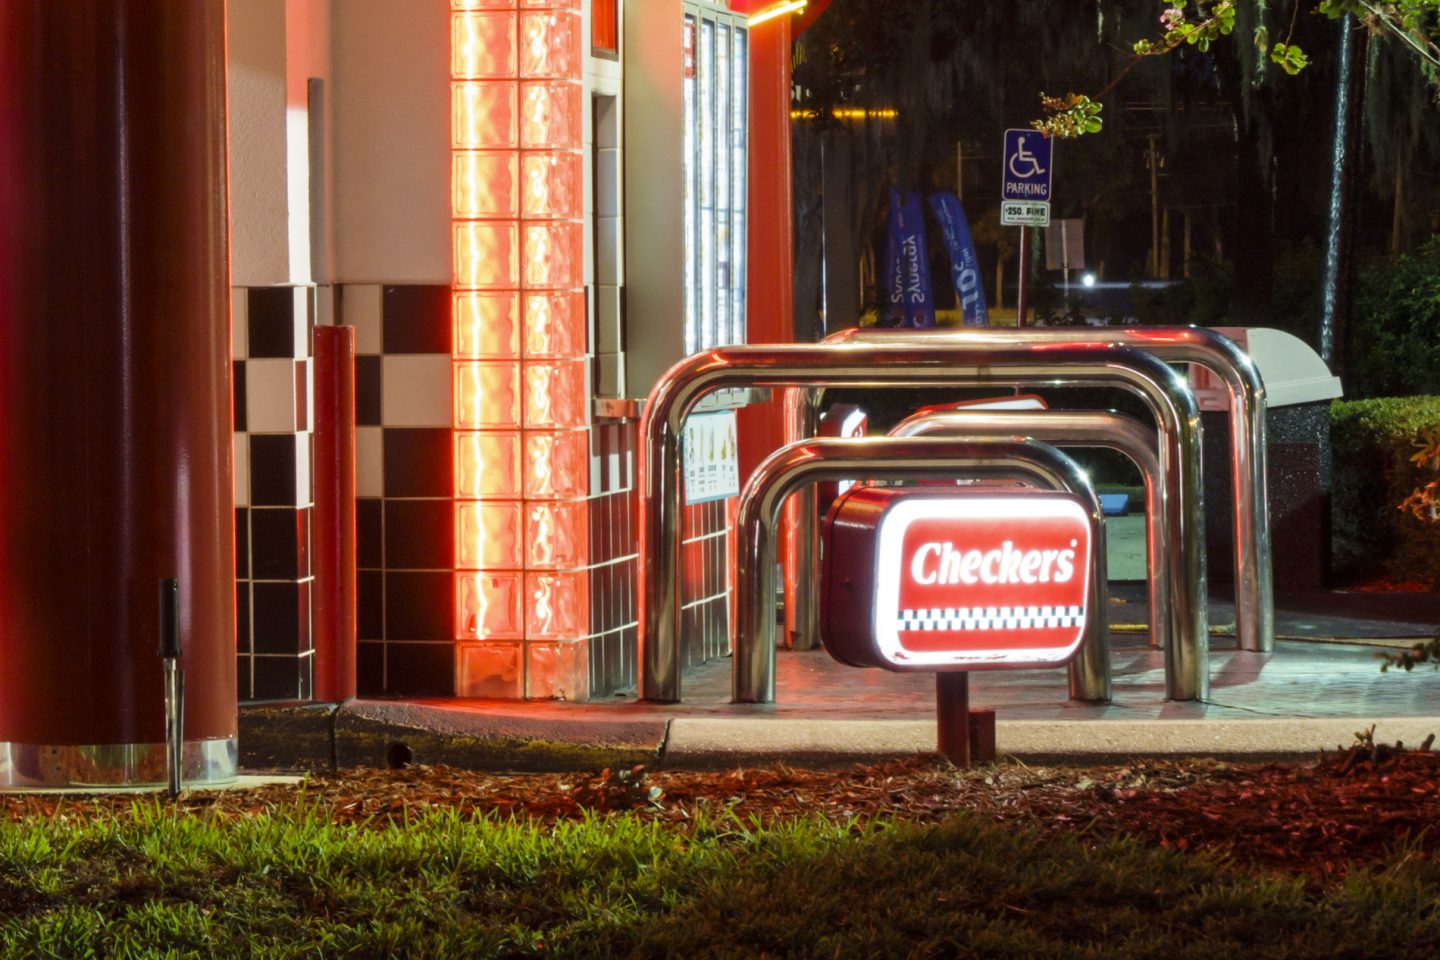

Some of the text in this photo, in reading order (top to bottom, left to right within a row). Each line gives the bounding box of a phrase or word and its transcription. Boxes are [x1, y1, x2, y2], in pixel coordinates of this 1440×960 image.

[1006, 182, 1047, 195] PARKING
[1026, 208, 1046, 216] FINE
[911, 540, 1076, 584] Checkers
